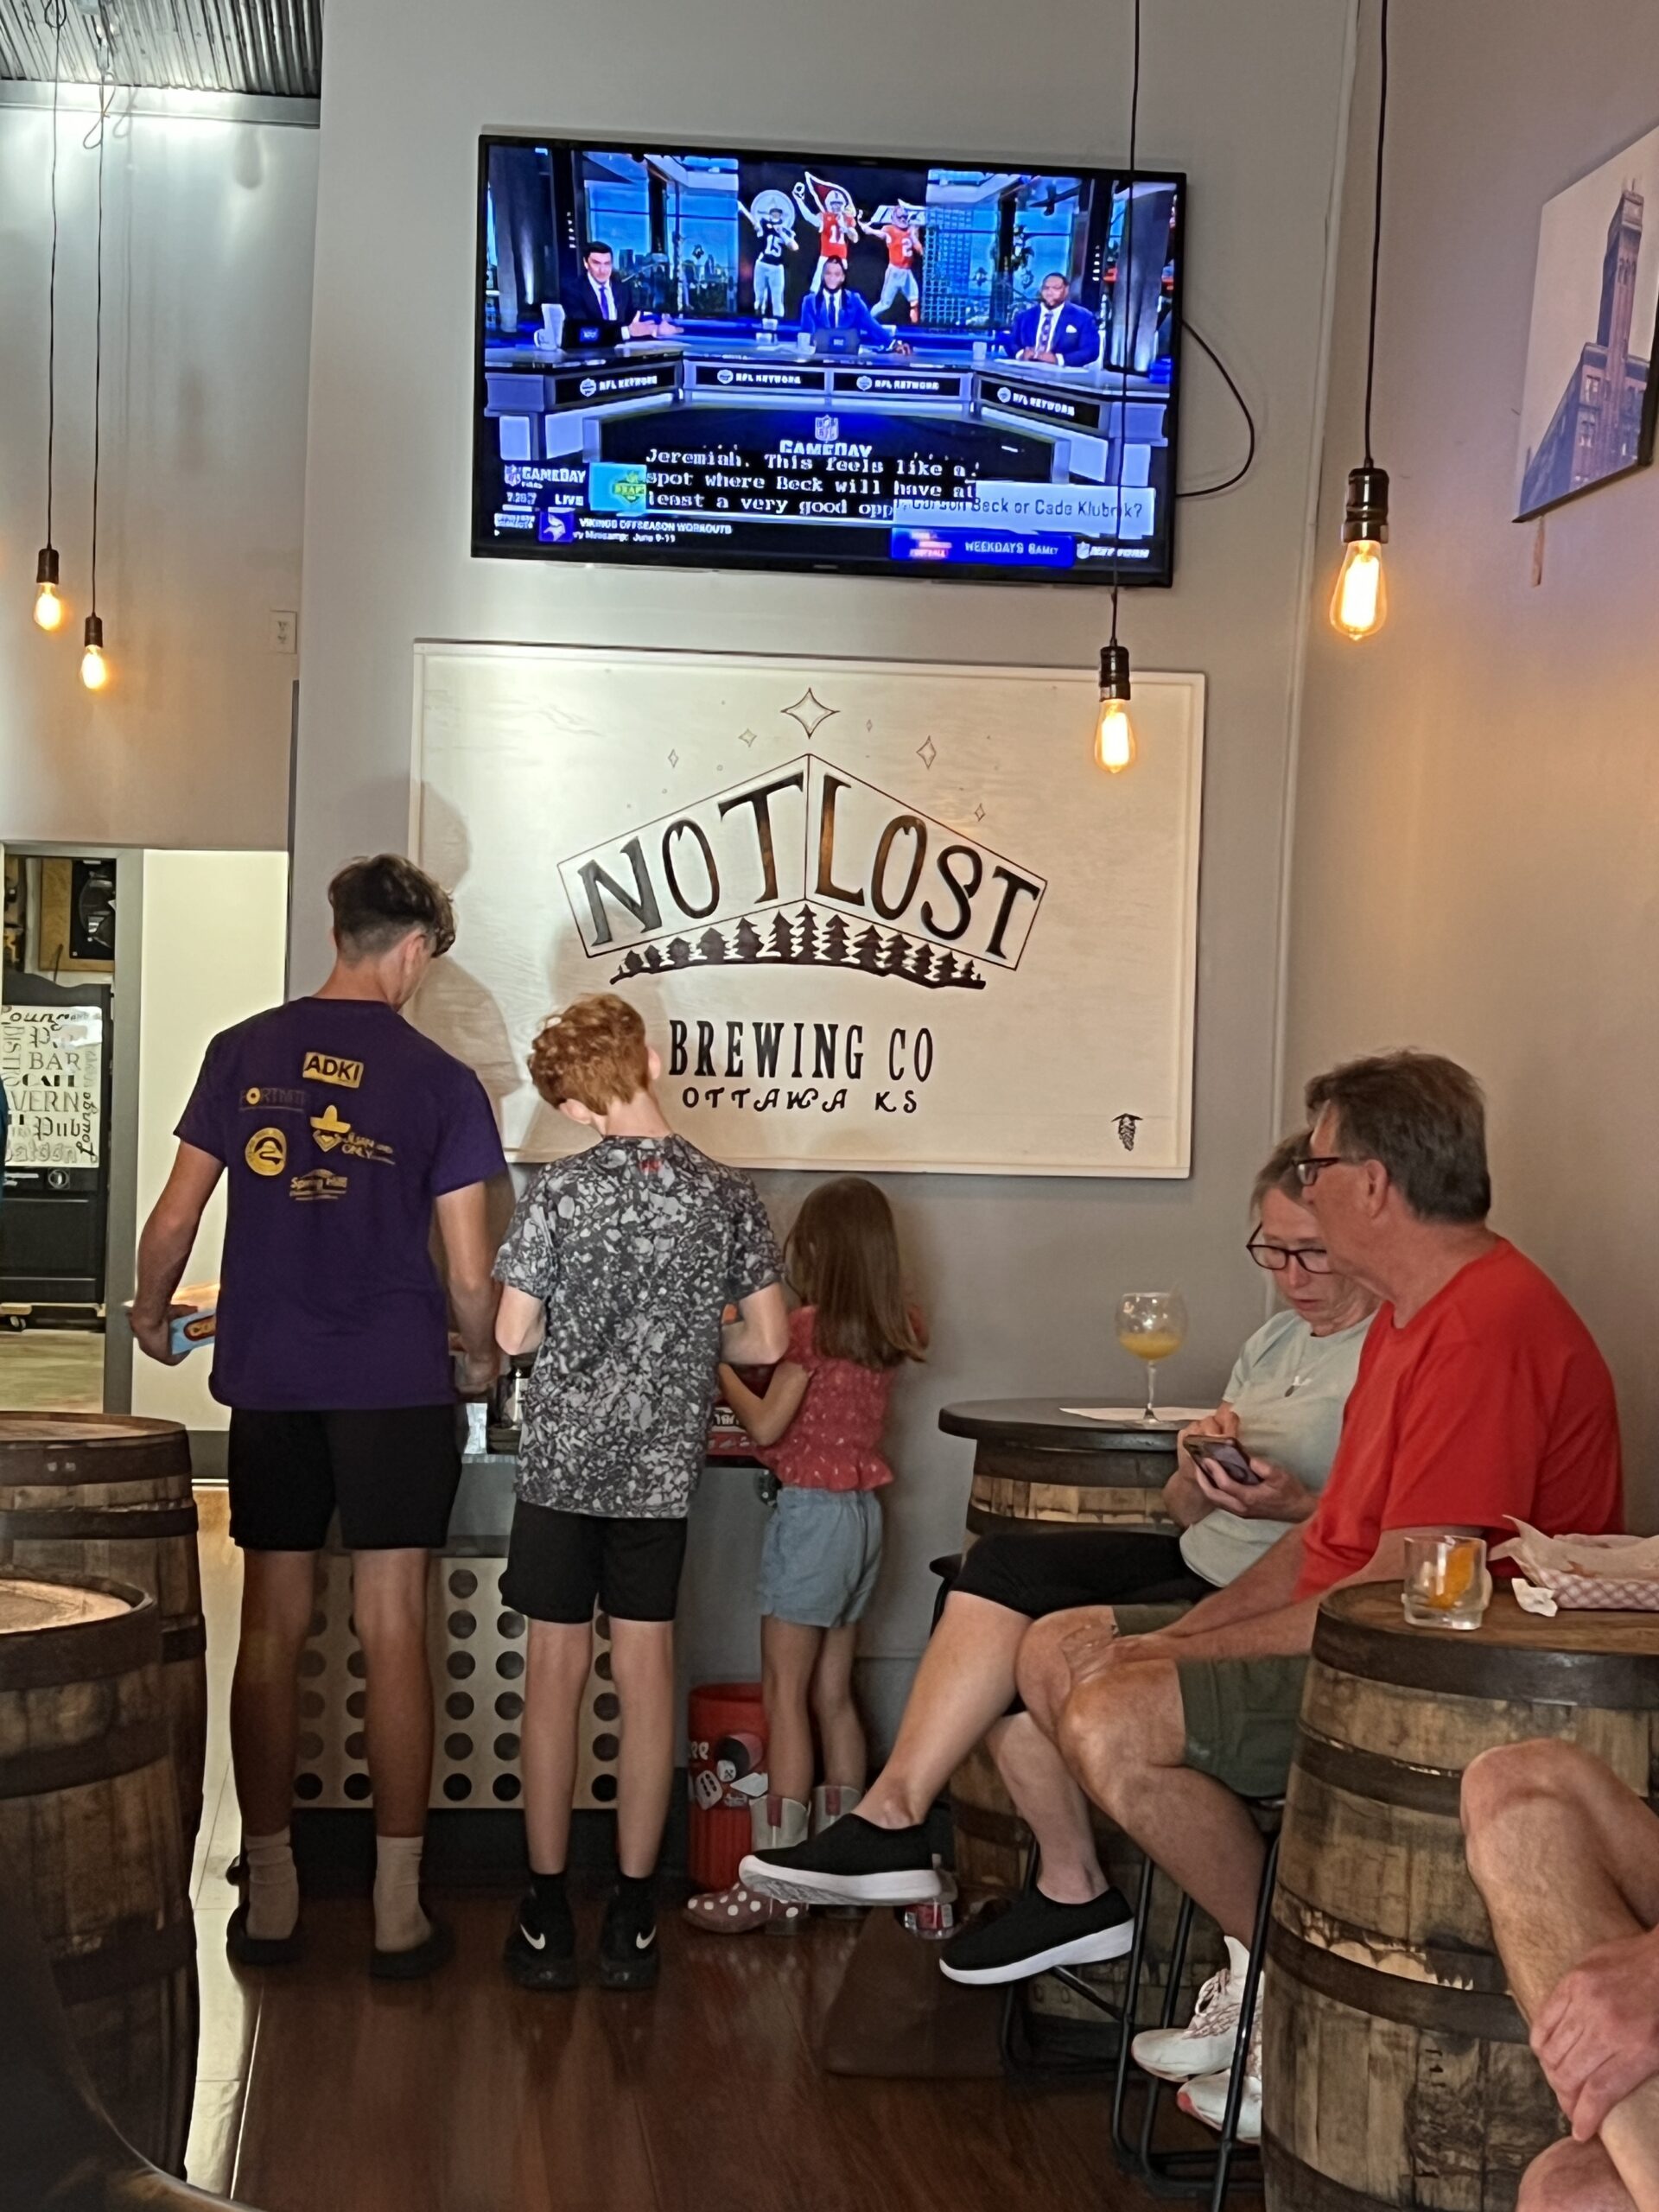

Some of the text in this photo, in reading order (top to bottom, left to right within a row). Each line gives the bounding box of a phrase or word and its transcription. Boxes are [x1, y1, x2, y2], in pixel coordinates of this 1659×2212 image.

[765, 233, 784, 257] 15
[901, 238, 913, 257] 2
[779, 440, 873, 458] GAMEDAY
[645, 448, 750, 468] Jeremiah.
[764, 453, 814, 470] This
[825, 456, 884, 474] feels
[896, 459, 943, 476] like
[522, 466, 587, 484] GAMEDAY
[645, 472, 694, 487] spot
[704, 473, 766, 489] where
[776, 475, 823, 493] Beck
[835, 479, 881, 495] will
[893, 480, 943, 497] have
[554, 493, 584, 506] LIVE
[648, 490, 705, 508] least
[715, 496, 729, 509] a
[740, 498, 789, 514] very
[798, 499, 848, 515] good
[972, 497, 1009, 513] Beck
[1014, 500, 1031, 513] or
[1036, 499, 1073, 516] Cade
[964, 540, 1024, 555] WEEKDAYS
[577, 769, 1041, 961] NOT LOST
[29, 1052, 81, 1071] BAR
[668, 1018, 934, 1083] BREWING CO
[304, 1054, 361, 1082] ADKI
[10, 1090, 80, 1113] VERN
[682, 1085, 918, 1115] OTTAWA KS
[34, 1116, 81, 1141] Pub
